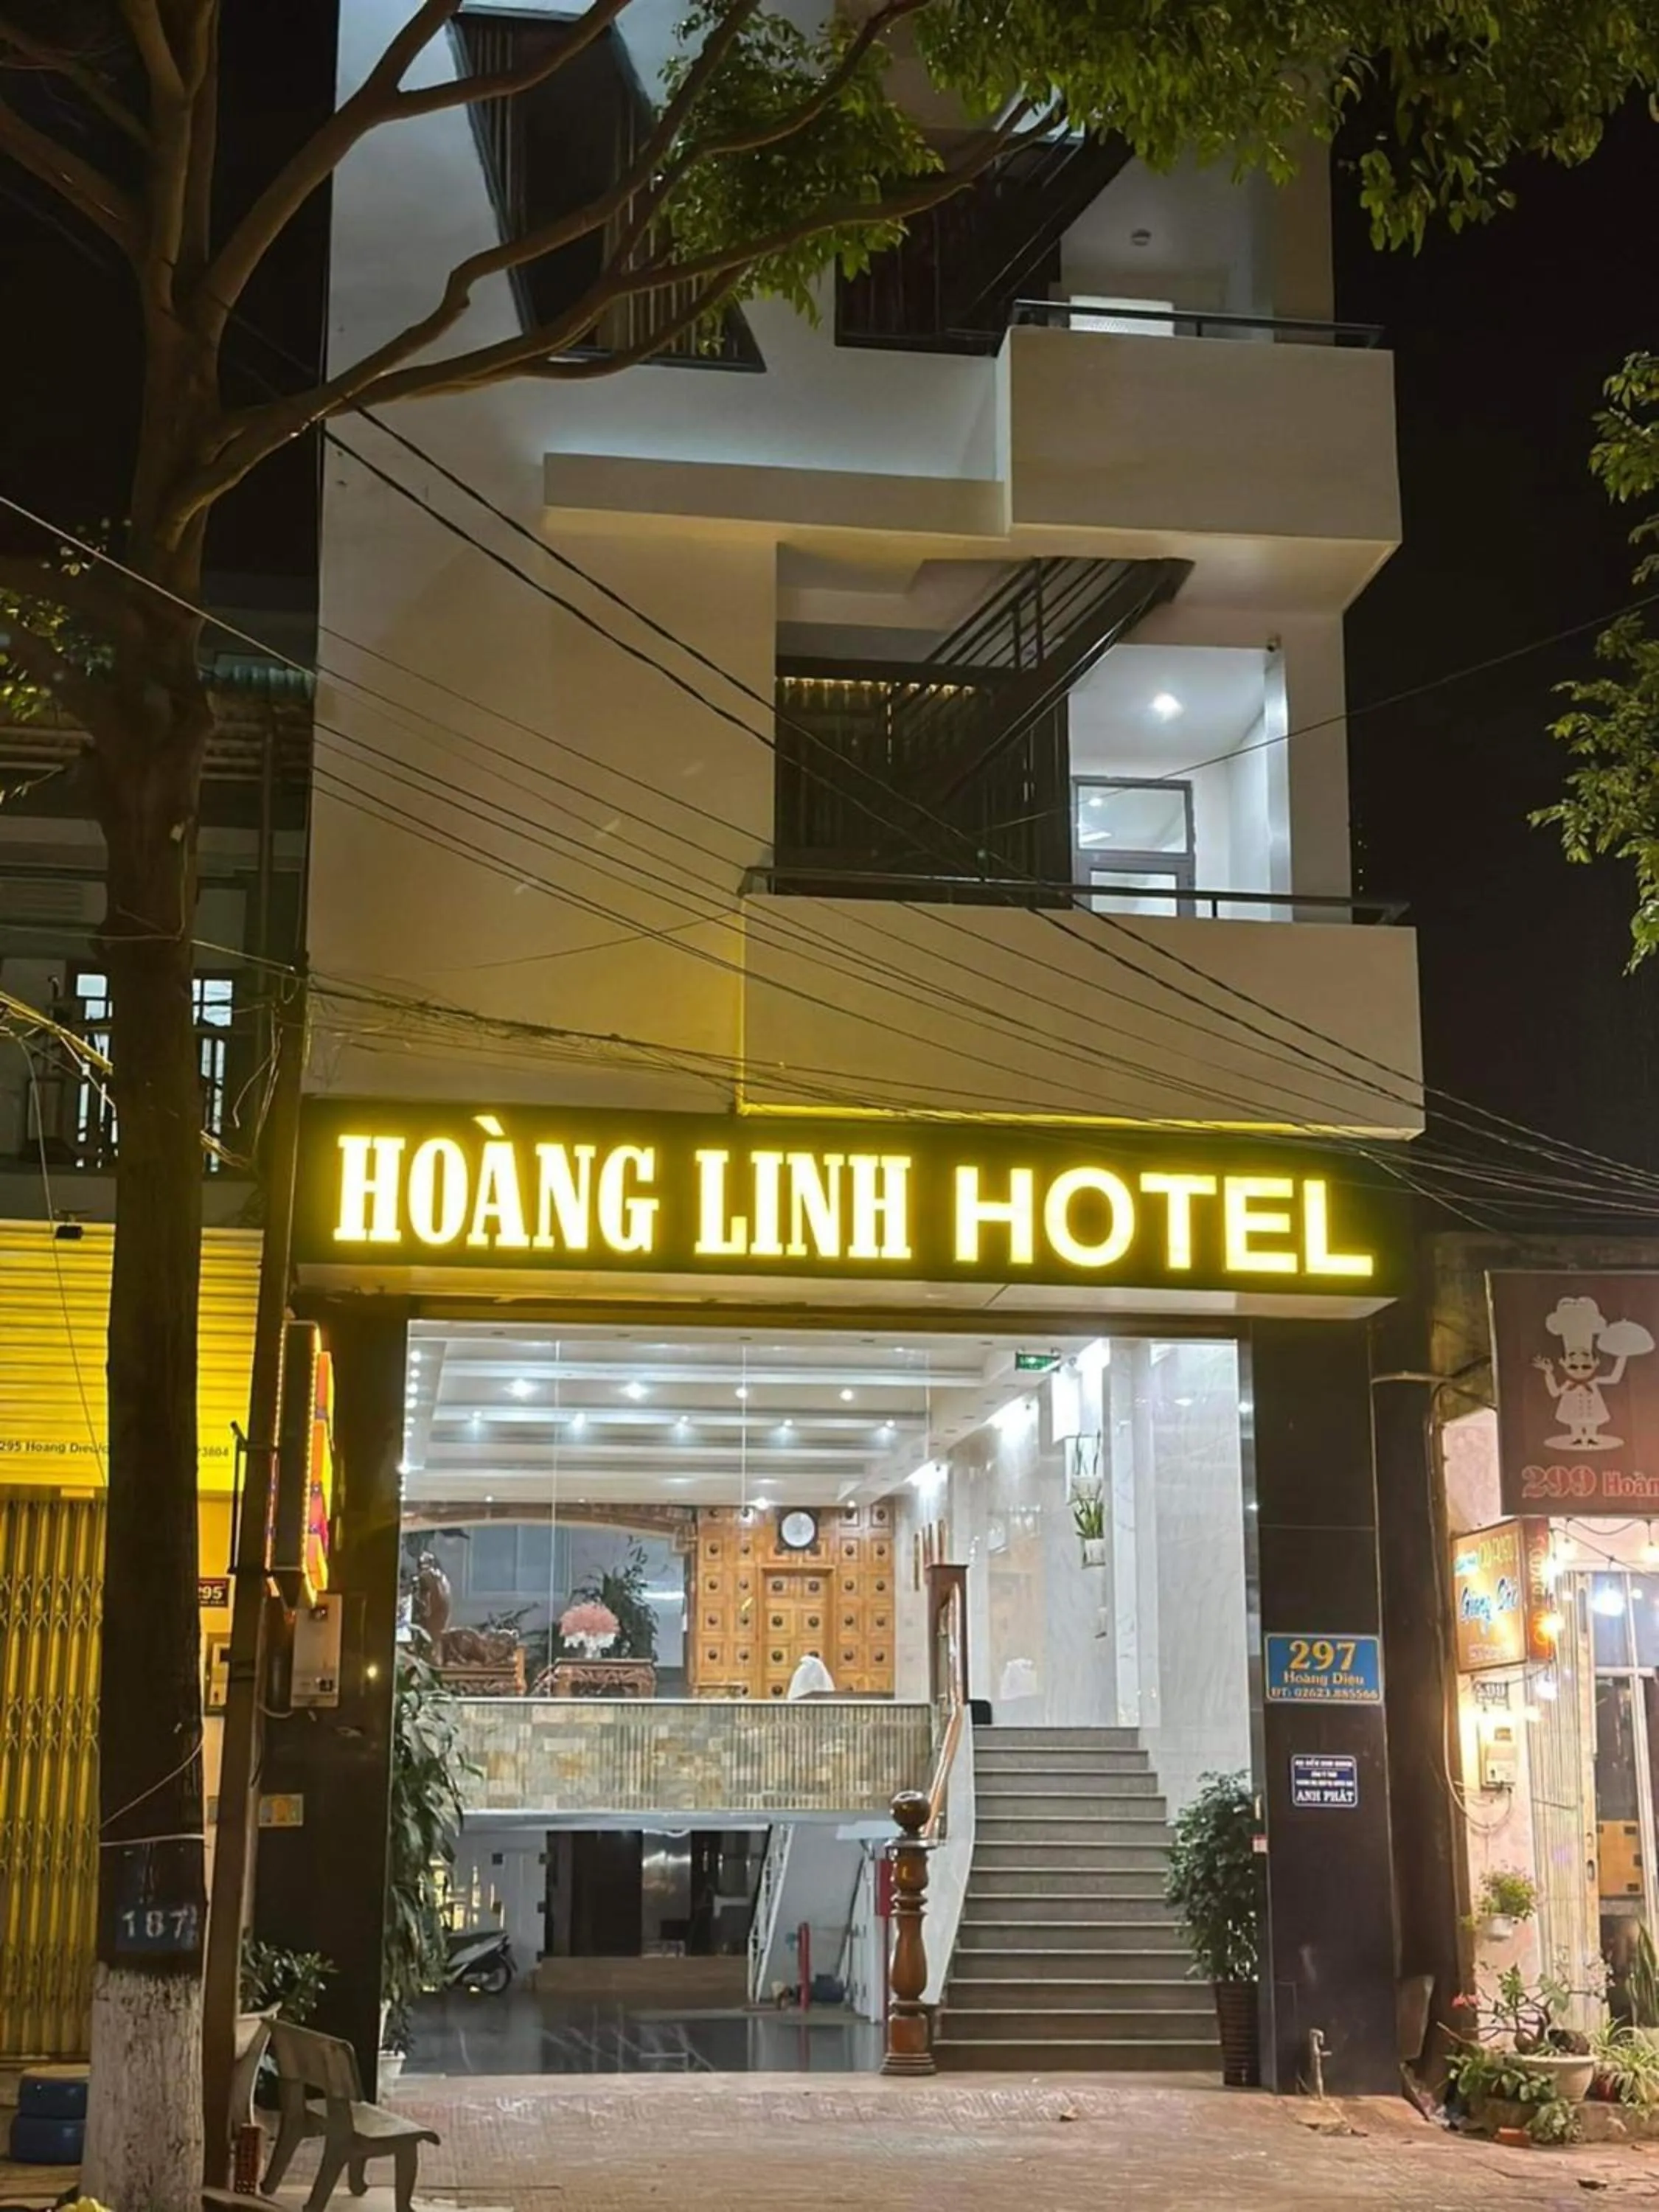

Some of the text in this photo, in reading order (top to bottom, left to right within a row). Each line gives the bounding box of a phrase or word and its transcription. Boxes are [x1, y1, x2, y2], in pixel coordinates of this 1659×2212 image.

[333, 1114, 1374, 1276] HOÀNG LINH HOTEL
[1520, 1464, 1598, 1499] 299
[198, 1585, 223, 1600] 95
[1288, 1639, 1357, 1671] 297
